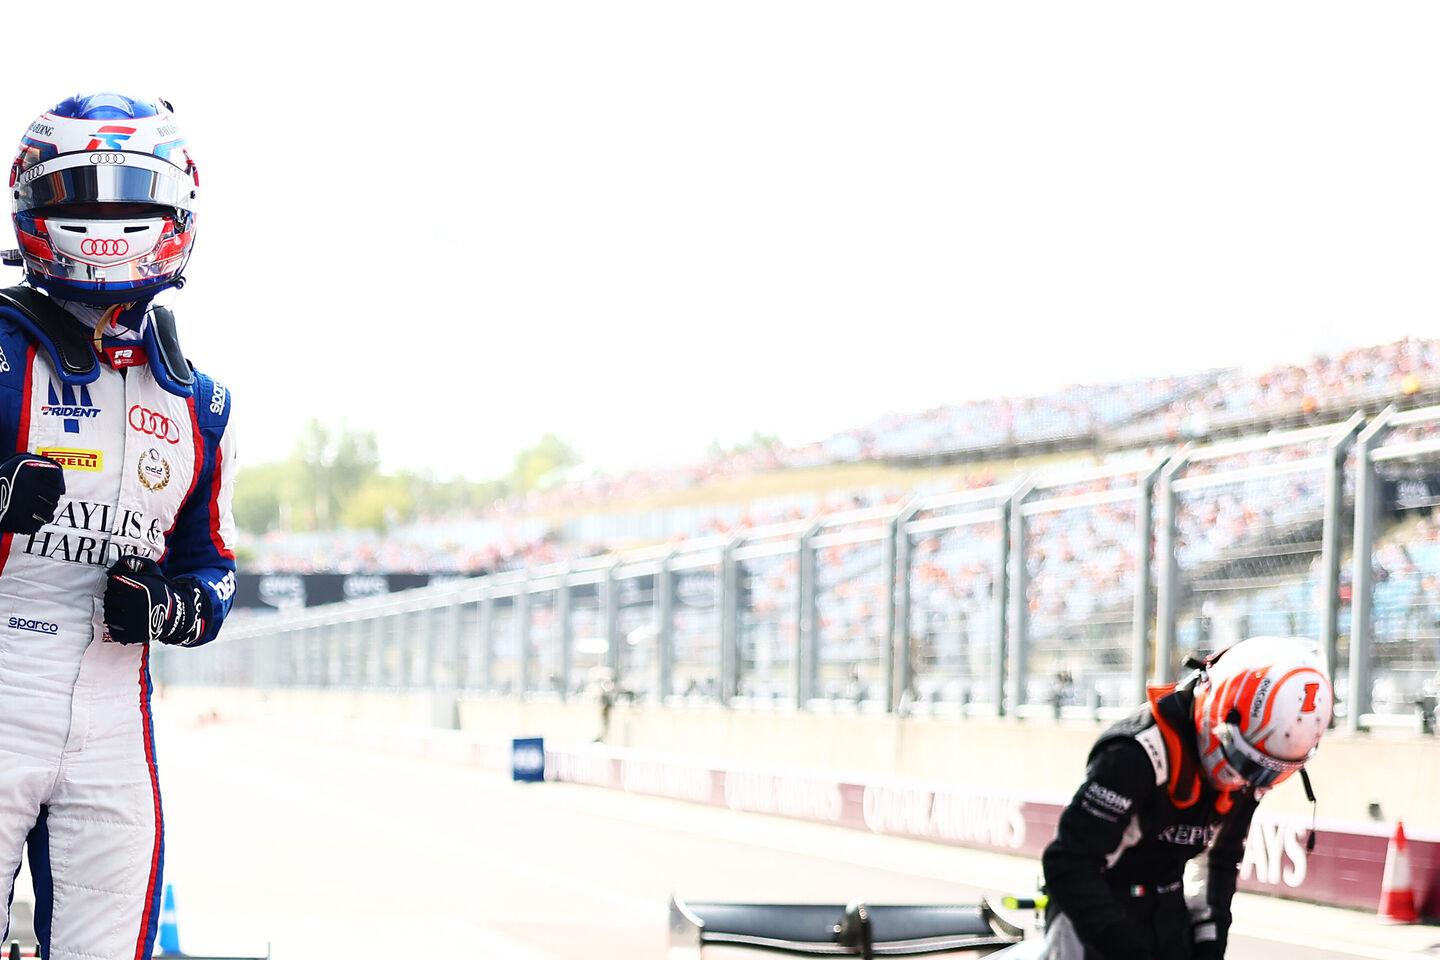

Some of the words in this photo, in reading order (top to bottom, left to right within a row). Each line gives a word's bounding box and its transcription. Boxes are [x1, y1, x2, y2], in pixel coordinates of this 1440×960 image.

[209, 378, 227, 416] spar
[41, 405, 101, 419] TRIDENT
[53, 500, 143, 540] AYLIS
[146, 518, 162, 546] &
[7, 616, 59, 635] sparco
